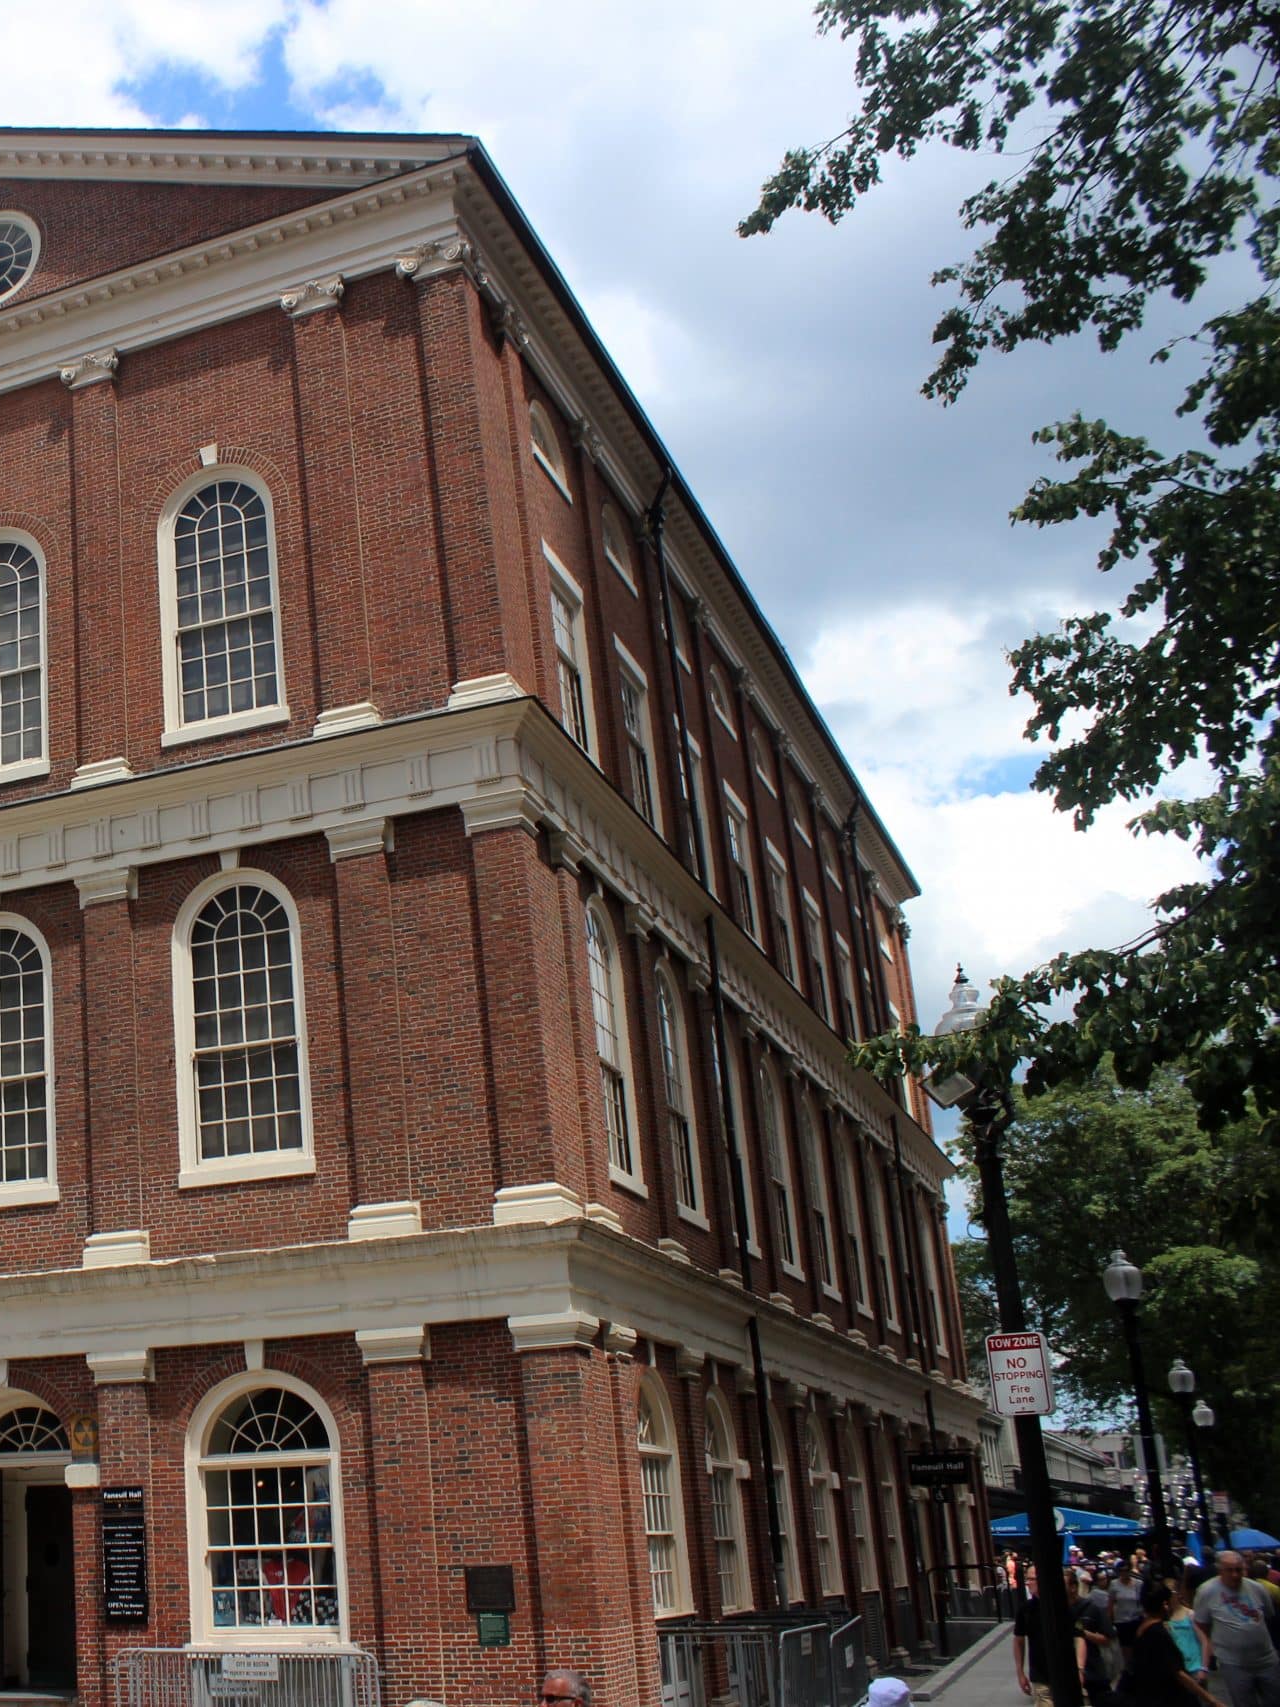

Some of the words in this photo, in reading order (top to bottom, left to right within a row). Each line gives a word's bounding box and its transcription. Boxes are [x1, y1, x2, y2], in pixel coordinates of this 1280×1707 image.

[989, 1338, 1011, 1349] TOW
[1012, 1336, 1040, 1347] ZONE
[1006, 1357, 1027, 1368] NO
[994, 1370, 1044, 1381] STOPPING
[1010, 1385, 1031, 1393] Fire
[1009, 1395, 1035, 1404] Lane
[946, 1461, 965, 1470] Hall
[103, 1490, 127, 1499] Faneuil
[128, 1490, 142, 1498] Hall
